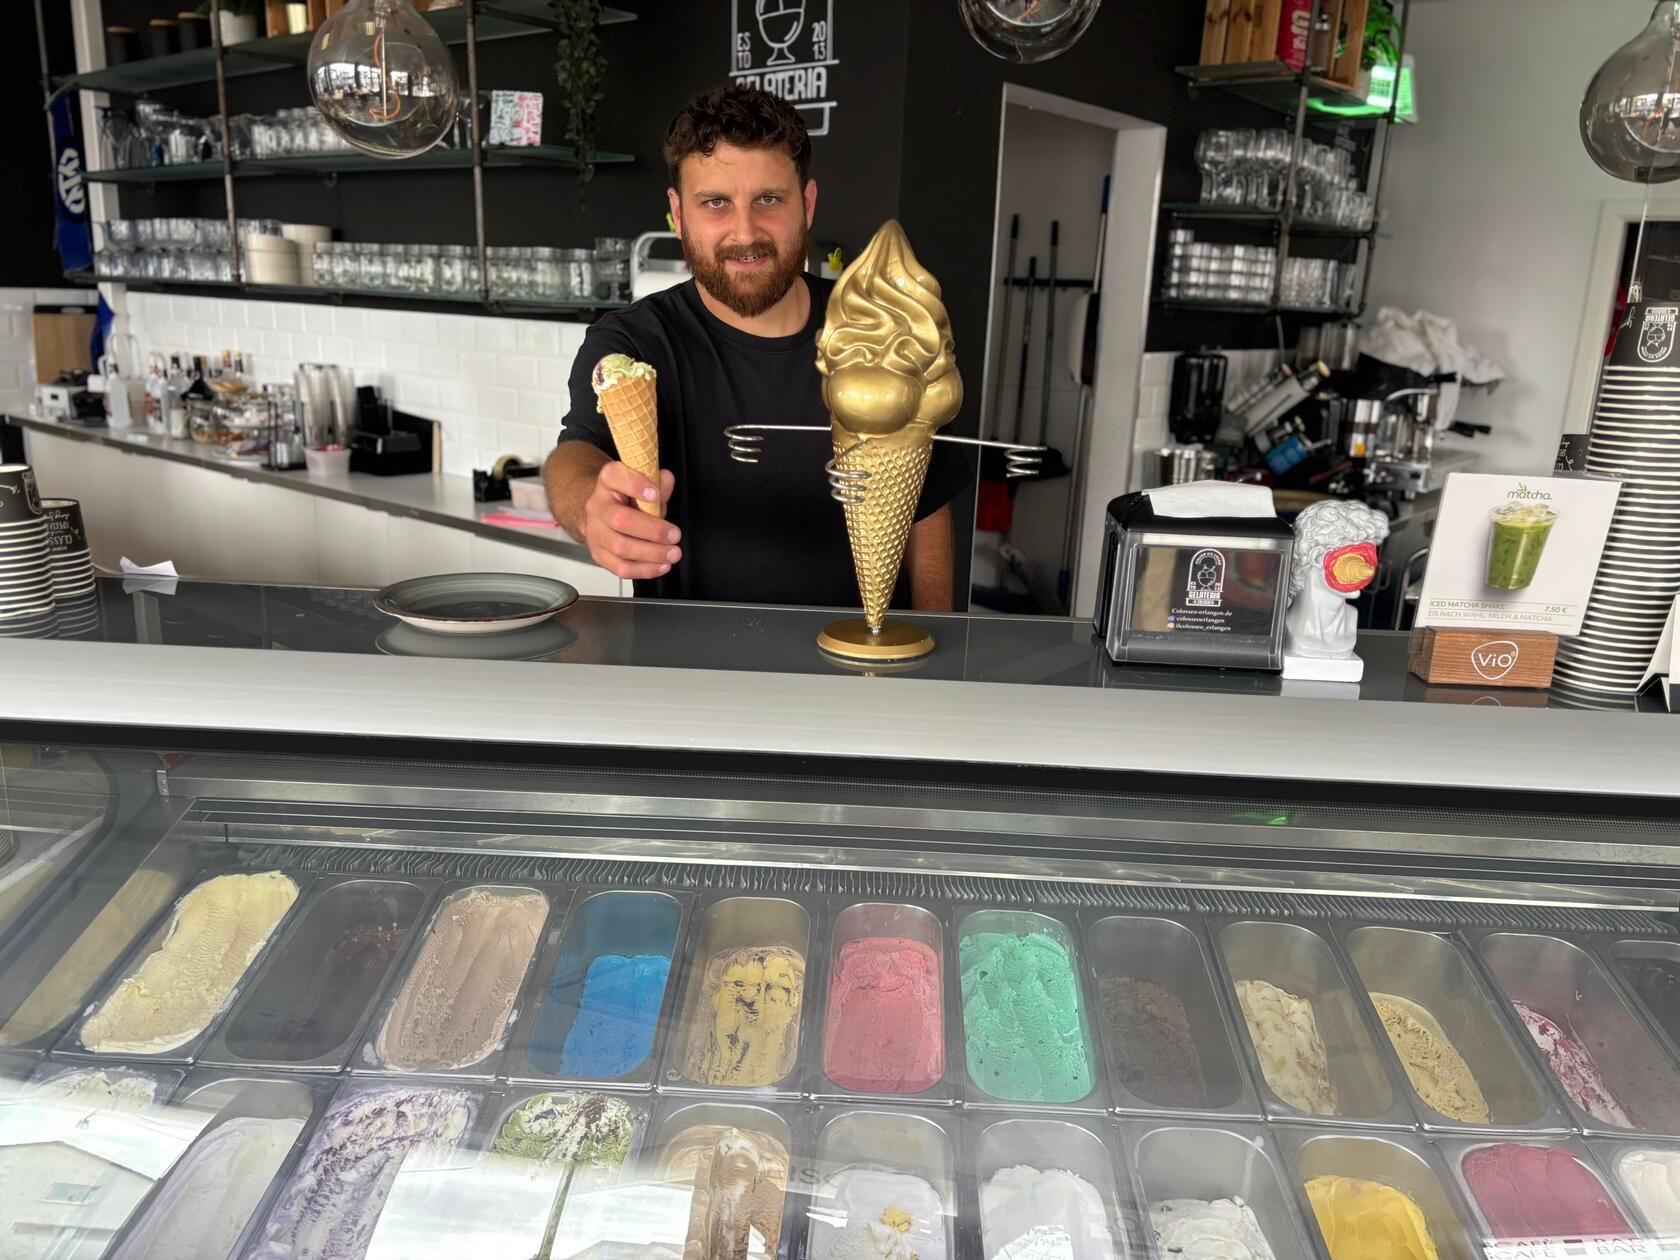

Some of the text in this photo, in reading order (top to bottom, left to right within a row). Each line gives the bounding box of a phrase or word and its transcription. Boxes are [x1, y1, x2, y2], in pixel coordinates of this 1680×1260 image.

[812, 20, 826, 42] 20
[737, 32, 751, 51] ES
[812, 42, 826, 60] 13
[735, 67, 827, 101] ATERIA
[1429, 600, 1505, 610] ICED MATCHA SHAKE
[1544, 605, 1561, 614] 7.50
[1439, 610, 1461, 618] NACH
[1520, 613, 1553, 622] MATCHA
